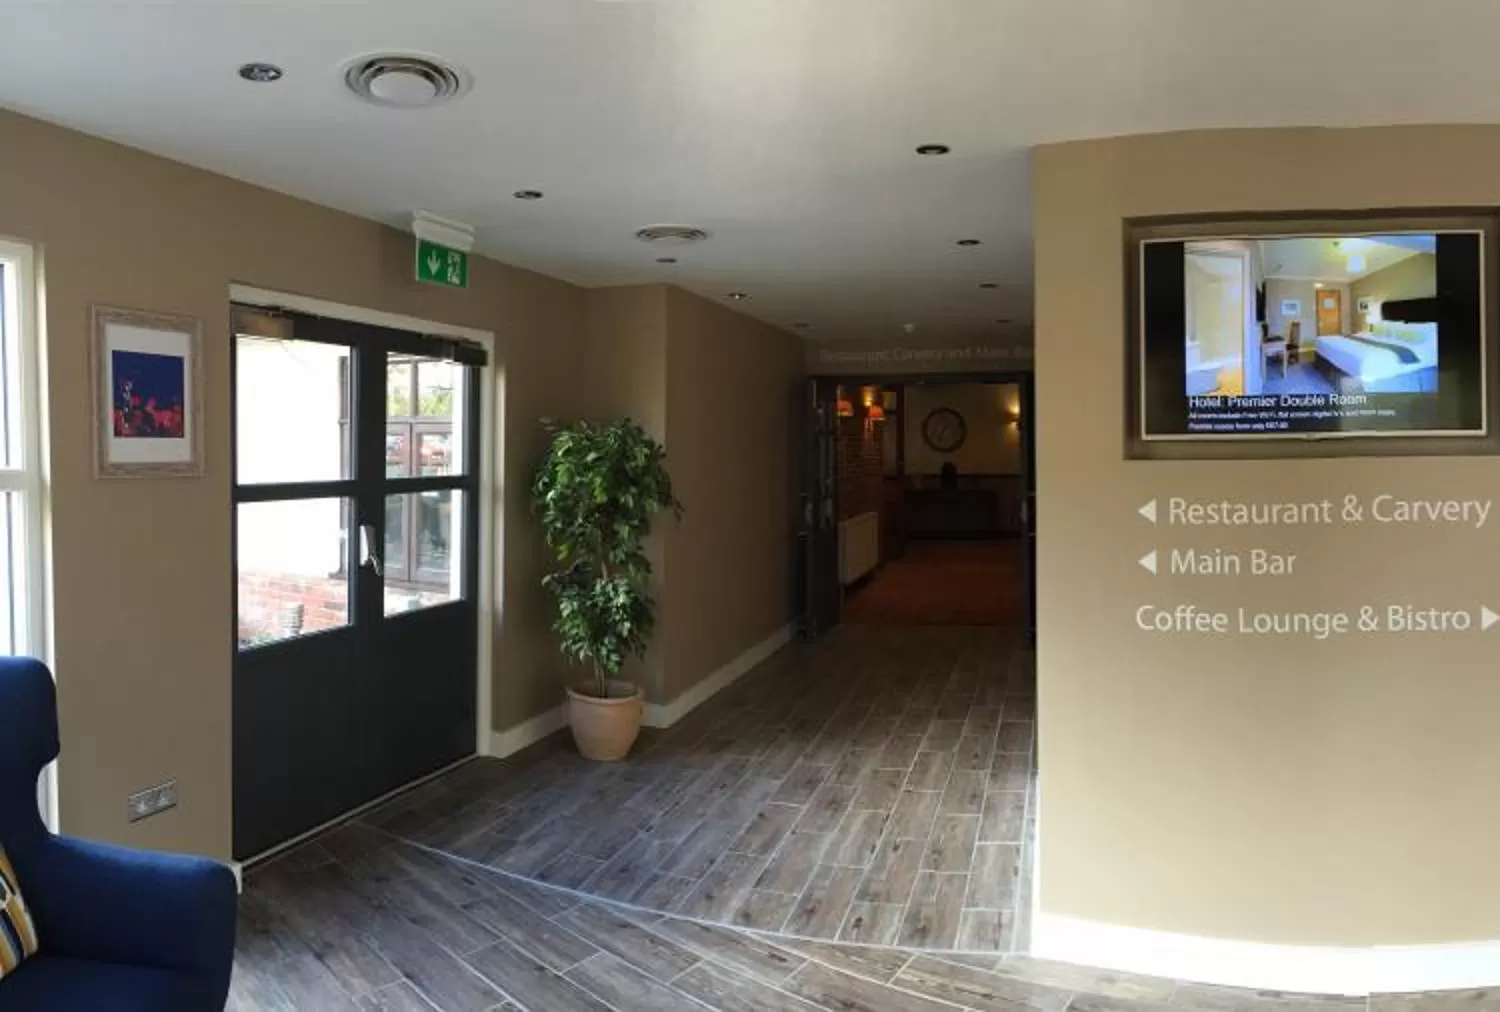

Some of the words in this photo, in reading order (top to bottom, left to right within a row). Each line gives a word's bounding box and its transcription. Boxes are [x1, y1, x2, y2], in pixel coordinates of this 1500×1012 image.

[1227, 396, 1275, 408] Premier
[1280, 394, 1325, 407] Double
[1329, 393, 1367, 405] Room
[1168, 497, 1334, 525] Restaurant
[1340, 496, 1364, 522] &
[1371, 494, 1493, 529] Carvery
[1170, 548, 1241, 575] Main
[1249, 549, 1297, 575] Bar
[1135, 605, 1229, 633] Coffee
[1238, 607, 1350, 640] Lounge
[1356, 604, 1380, 632] &
[1387, 604, 1472, 632] Bistro
